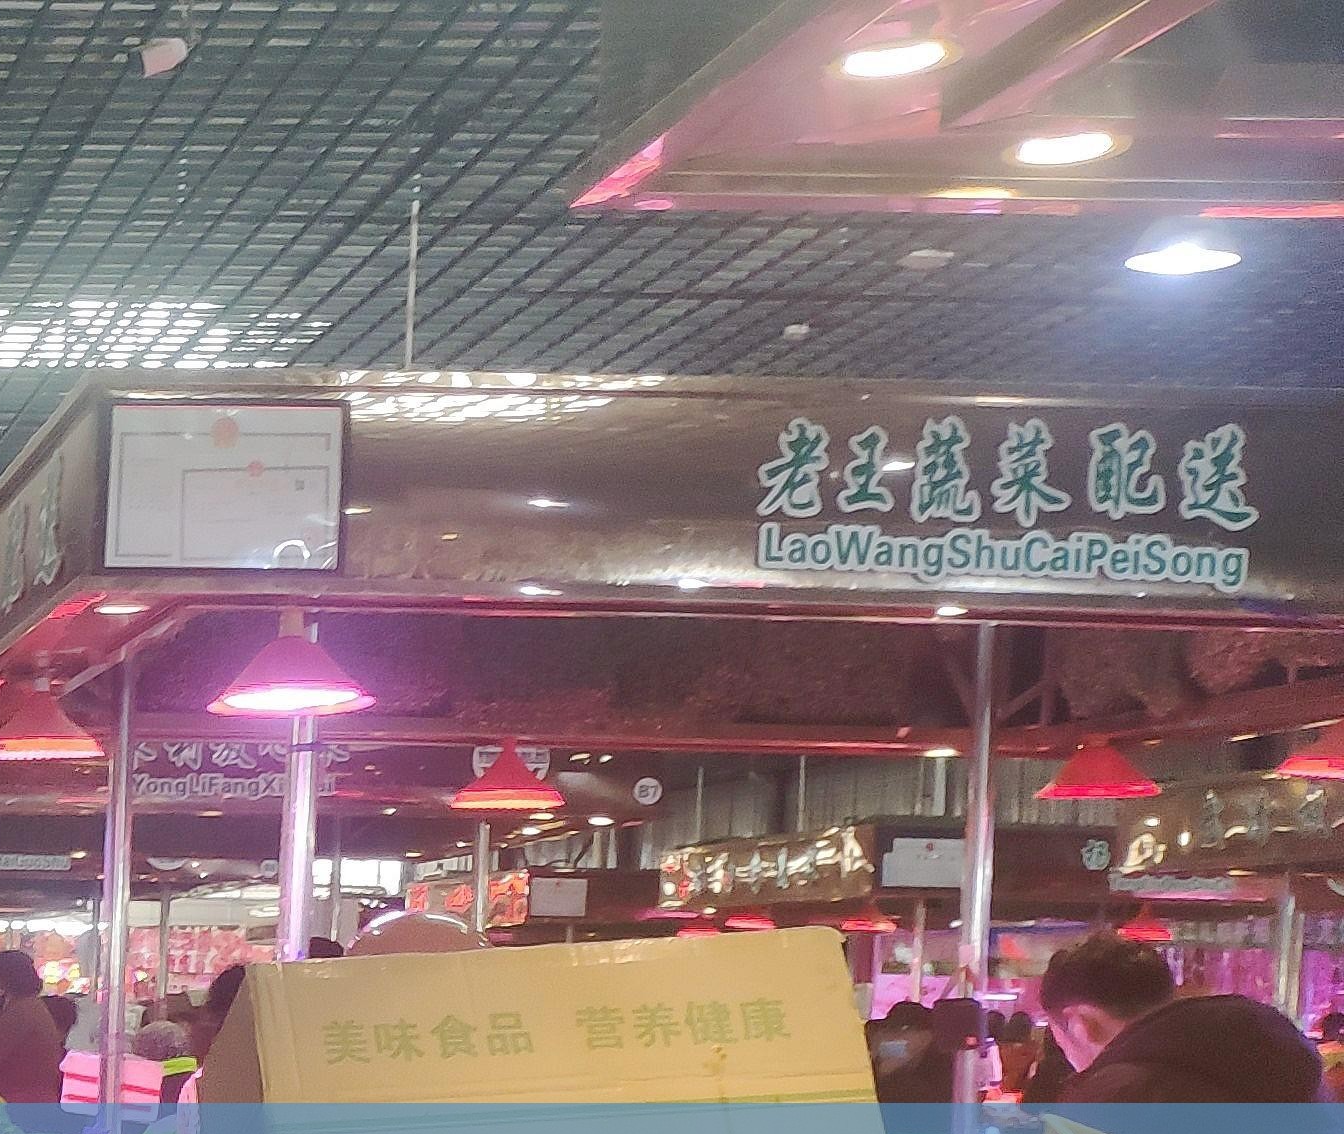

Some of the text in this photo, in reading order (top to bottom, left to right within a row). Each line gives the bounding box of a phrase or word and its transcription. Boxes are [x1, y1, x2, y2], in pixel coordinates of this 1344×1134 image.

[760, 418, 1258, 529] 老王蔬菜配送
[763, 530, 1247, 586] LaoWangShuCaiPeiSong
[321, 997, 792, 1065] 美味食品 营养健康
